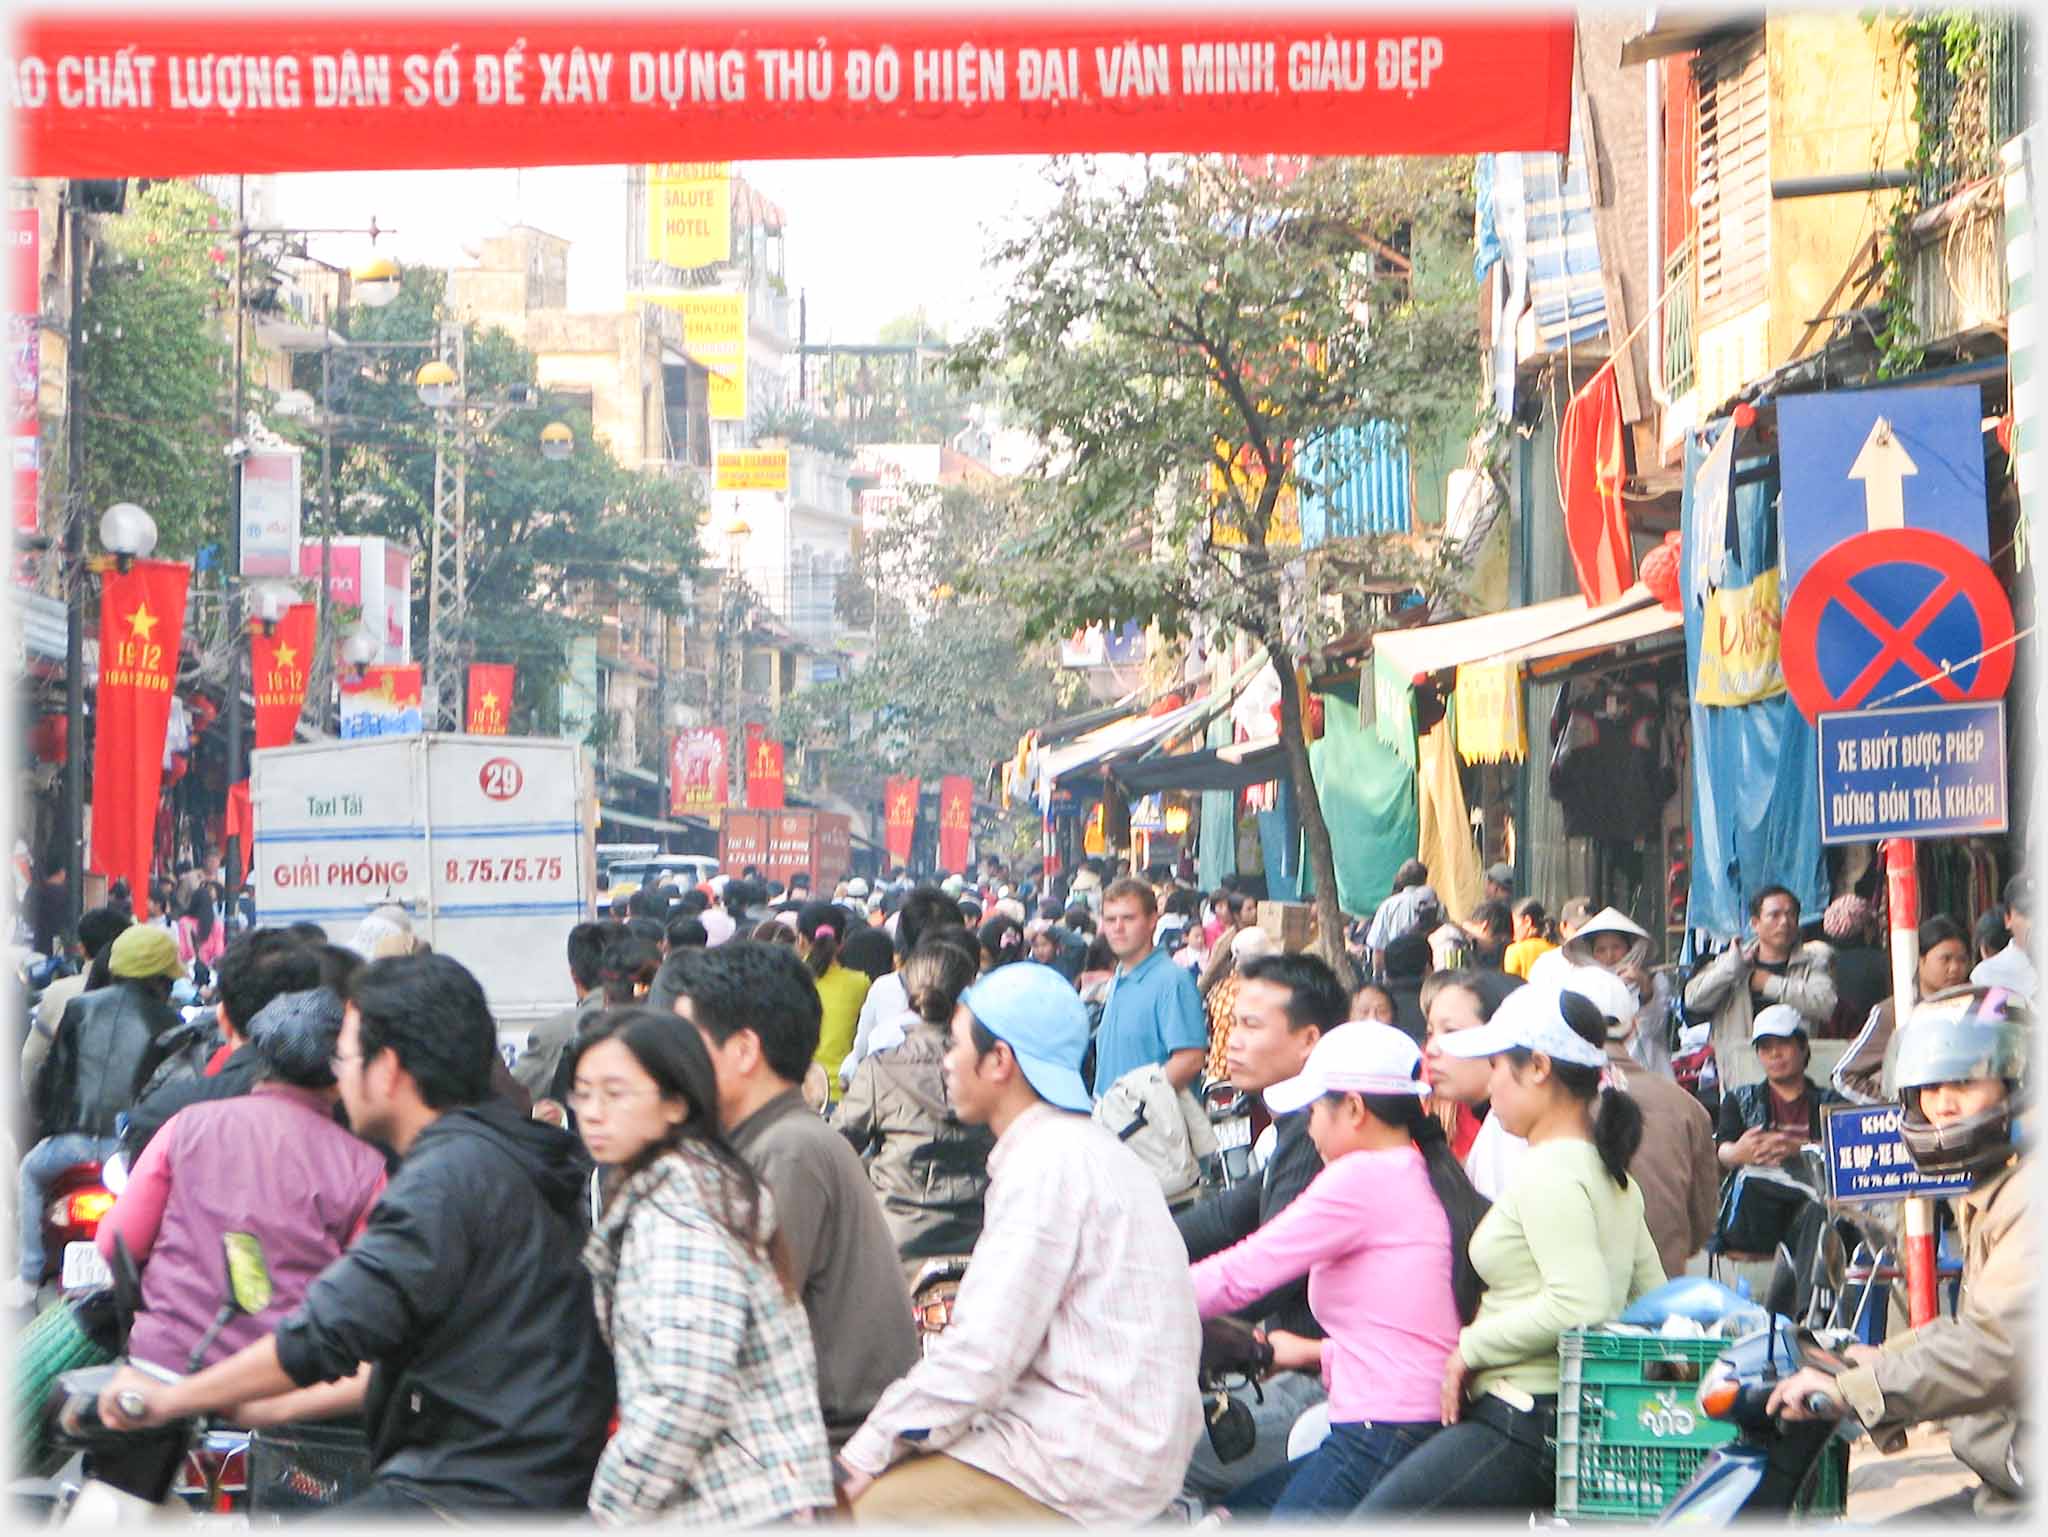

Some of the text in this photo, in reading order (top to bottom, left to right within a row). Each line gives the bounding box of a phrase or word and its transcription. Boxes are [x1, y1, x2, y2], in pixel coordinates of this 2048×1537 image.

[57, 43, 156, 108] CHẤT
[168, 53, 300, 116] LƯỢNG
[312, 48, 390, 107] DÂN
[403, 42, 461, 107] SỐ
[474, 36, 526, 105] ĐỂ
[538, 46, 612, 105] XÂY
[629, 47, 746, 110] DỰNG
[755, 36, 833, 102] THỦ
[844, 43, 899, 103] ĐÔ
[913, 41, 1006, 107] HIỆN
[1095, 38, 1170, 98] VĂN
[1288, 32, 1366, 92] GIÀU
[1375, 36, 1443, 99] ĐẸP
[664, 189, 715, 208] SALUTE
[666, 217, 711, 237] HOTEL
[1837, 723, 1985, 773] XE BUÝT ĐƯỢC PHÉP
[486, 764, 517, 797] 29
[1833, 771, 1995, 827] DỪNG ĐÓN TRẢ KHÁCH
[273, 855, 409, 889] GIẢI PHÓNG
[446, 856, 562, 884] 8.75.75.75
